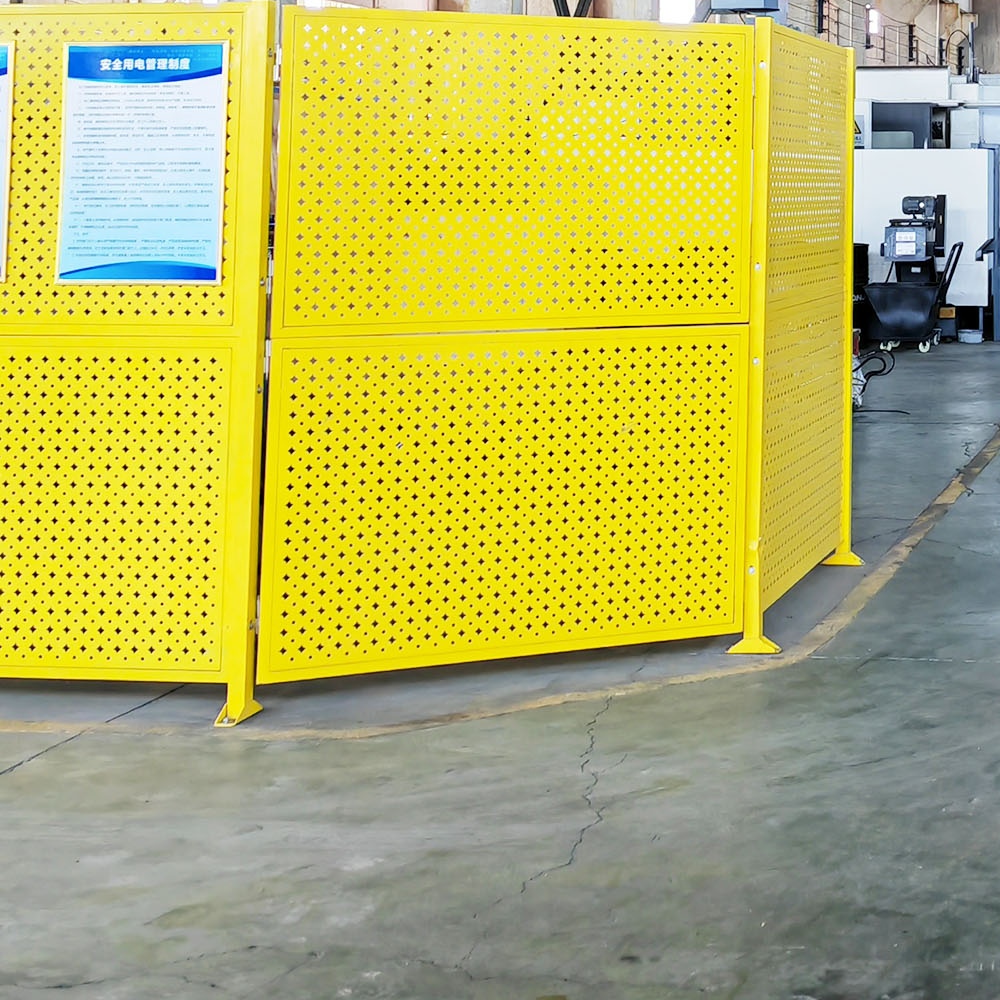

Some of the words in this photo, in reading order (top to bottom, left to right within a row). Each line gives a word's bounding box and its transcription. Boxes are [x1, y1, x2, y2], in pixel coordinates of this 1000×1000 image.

[100, 58, 190, 71] 安全用电管理制度
